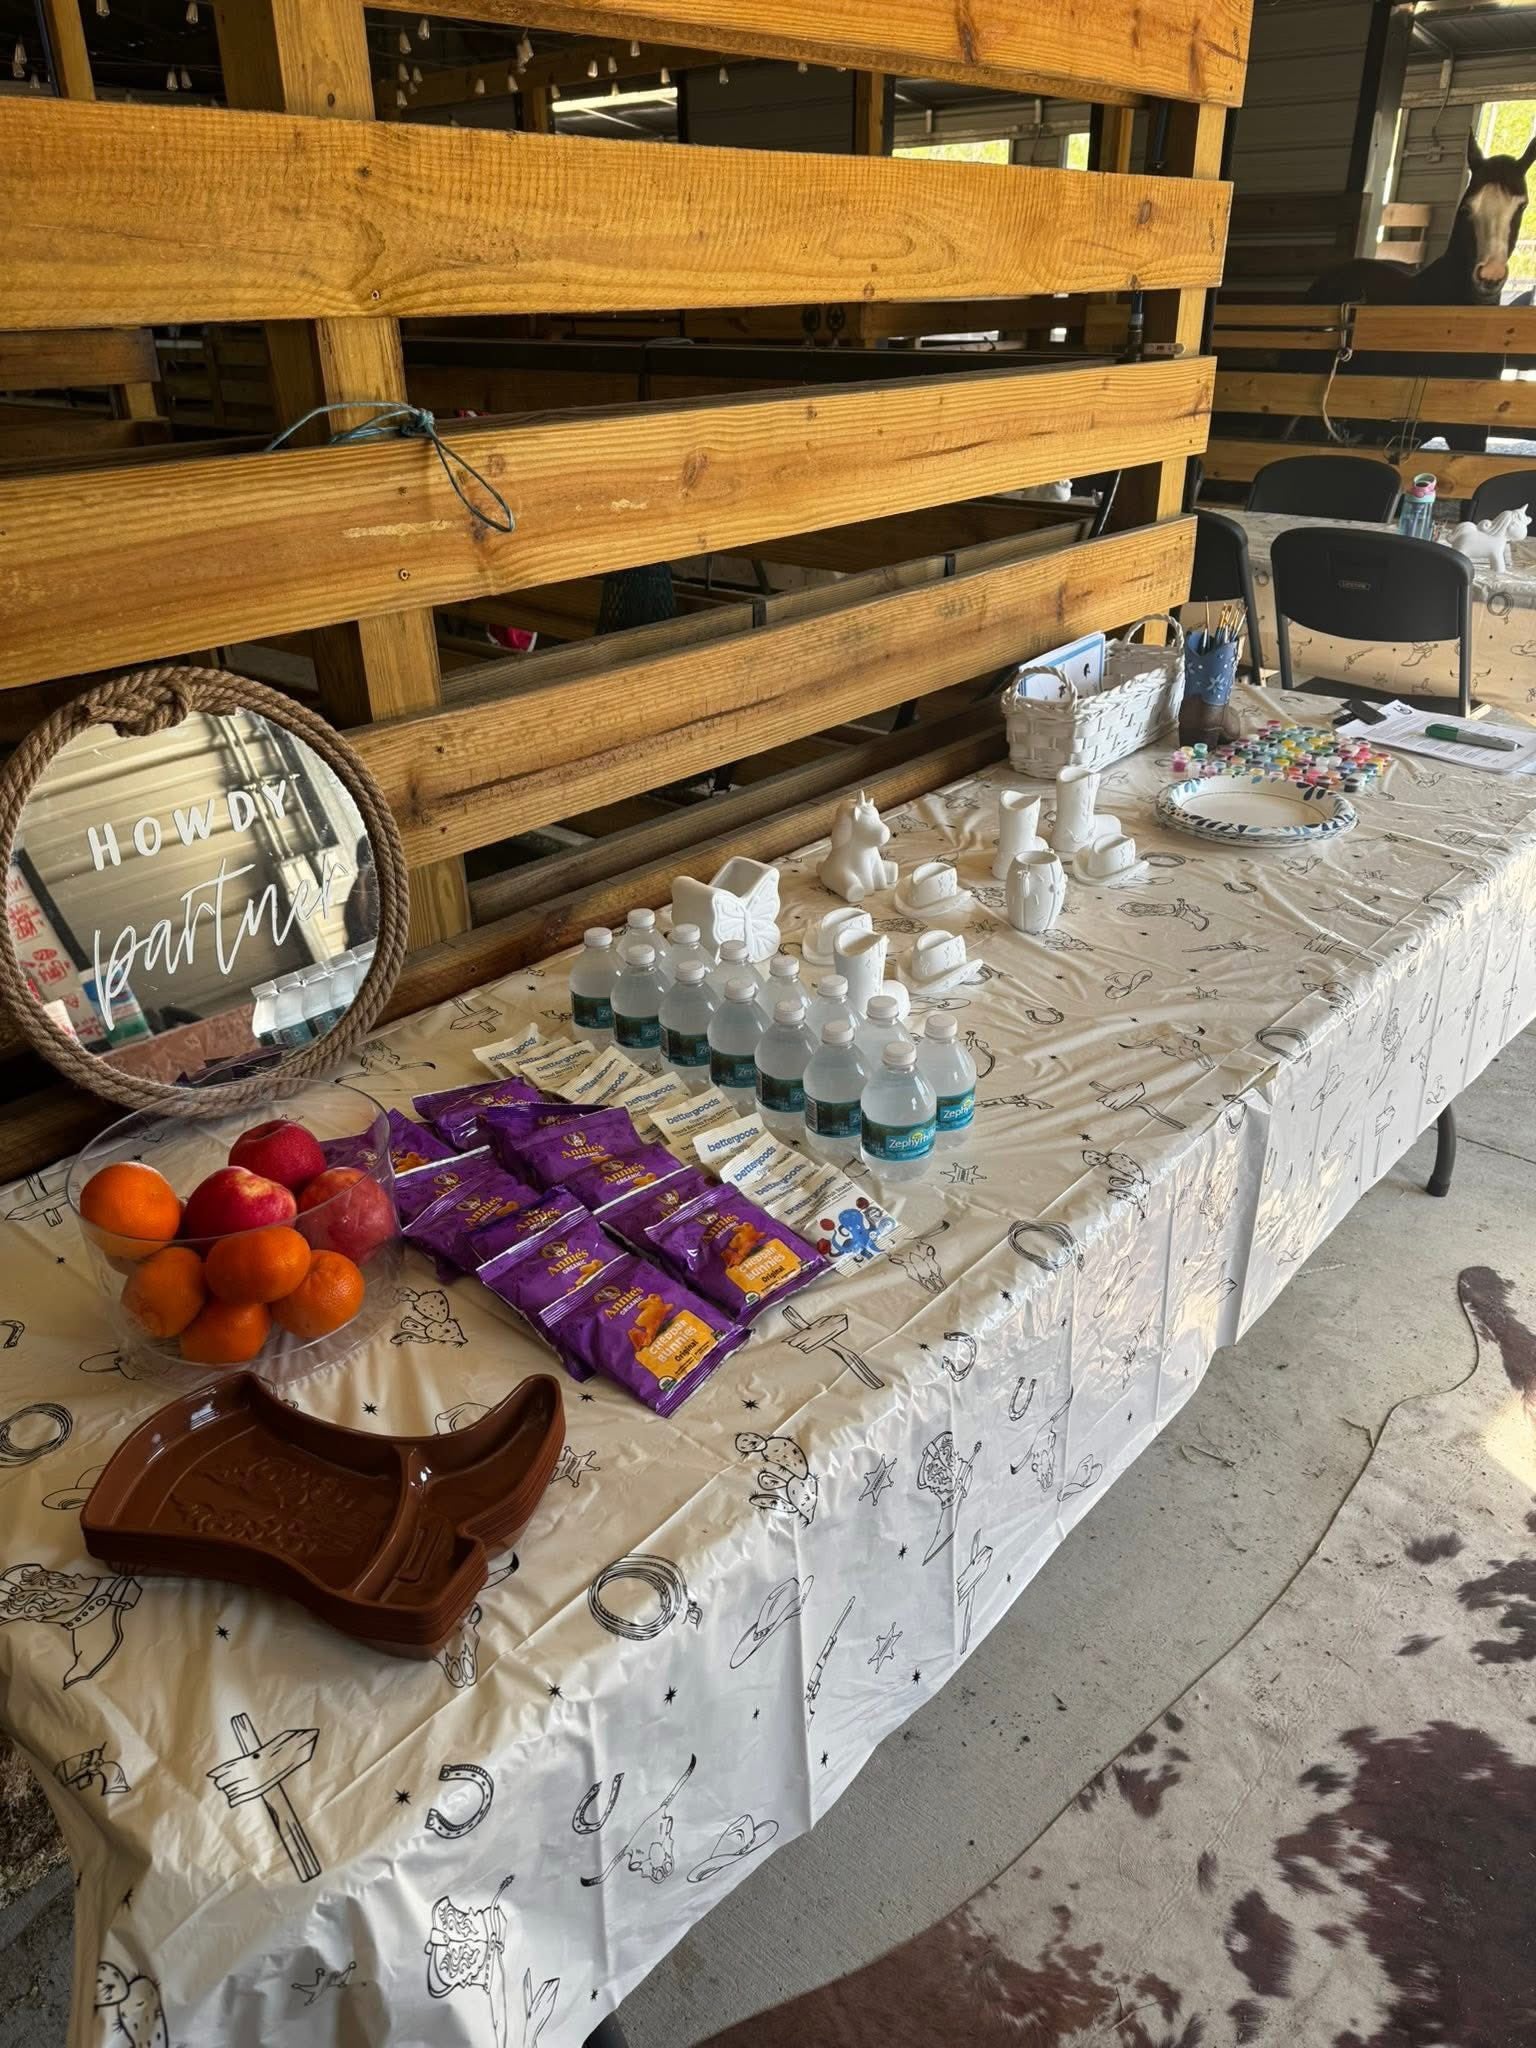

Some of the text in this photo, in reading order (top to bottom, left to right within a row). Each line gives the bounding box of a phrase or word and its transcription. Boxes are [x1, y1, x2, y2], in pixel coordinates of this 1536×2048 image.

[87, 779, 288, 871] HOWDY
[93, 855, 352, 1031] partner
[625, 1082, 677, 1106] bettergoods
[665, 1097, 721, 1124] bettergoods
[561, 1142, 605, 1159] Annie's
[707, 1127, 759, 1153] bettergoods
[603, 1162, 646, 1184] Annie's
[734, 1145, 777, 1181] bettergoods
[464, 1195, 503, 1226] Annie's
[515, 1207, 562, 1233] Annie's
[702, 1212, 740, 1245] Annie's
[547, 1247, 589, 1277] Annie's
[562, 1258, 588, 1275] ORGANIC
[761, 1265, 785, 1284] Original
[604, 1285, 645, 1319] Annie's
[620, 1295, 644, 1316] ORGANIC
[674, 1340, 699, 1362] Original
